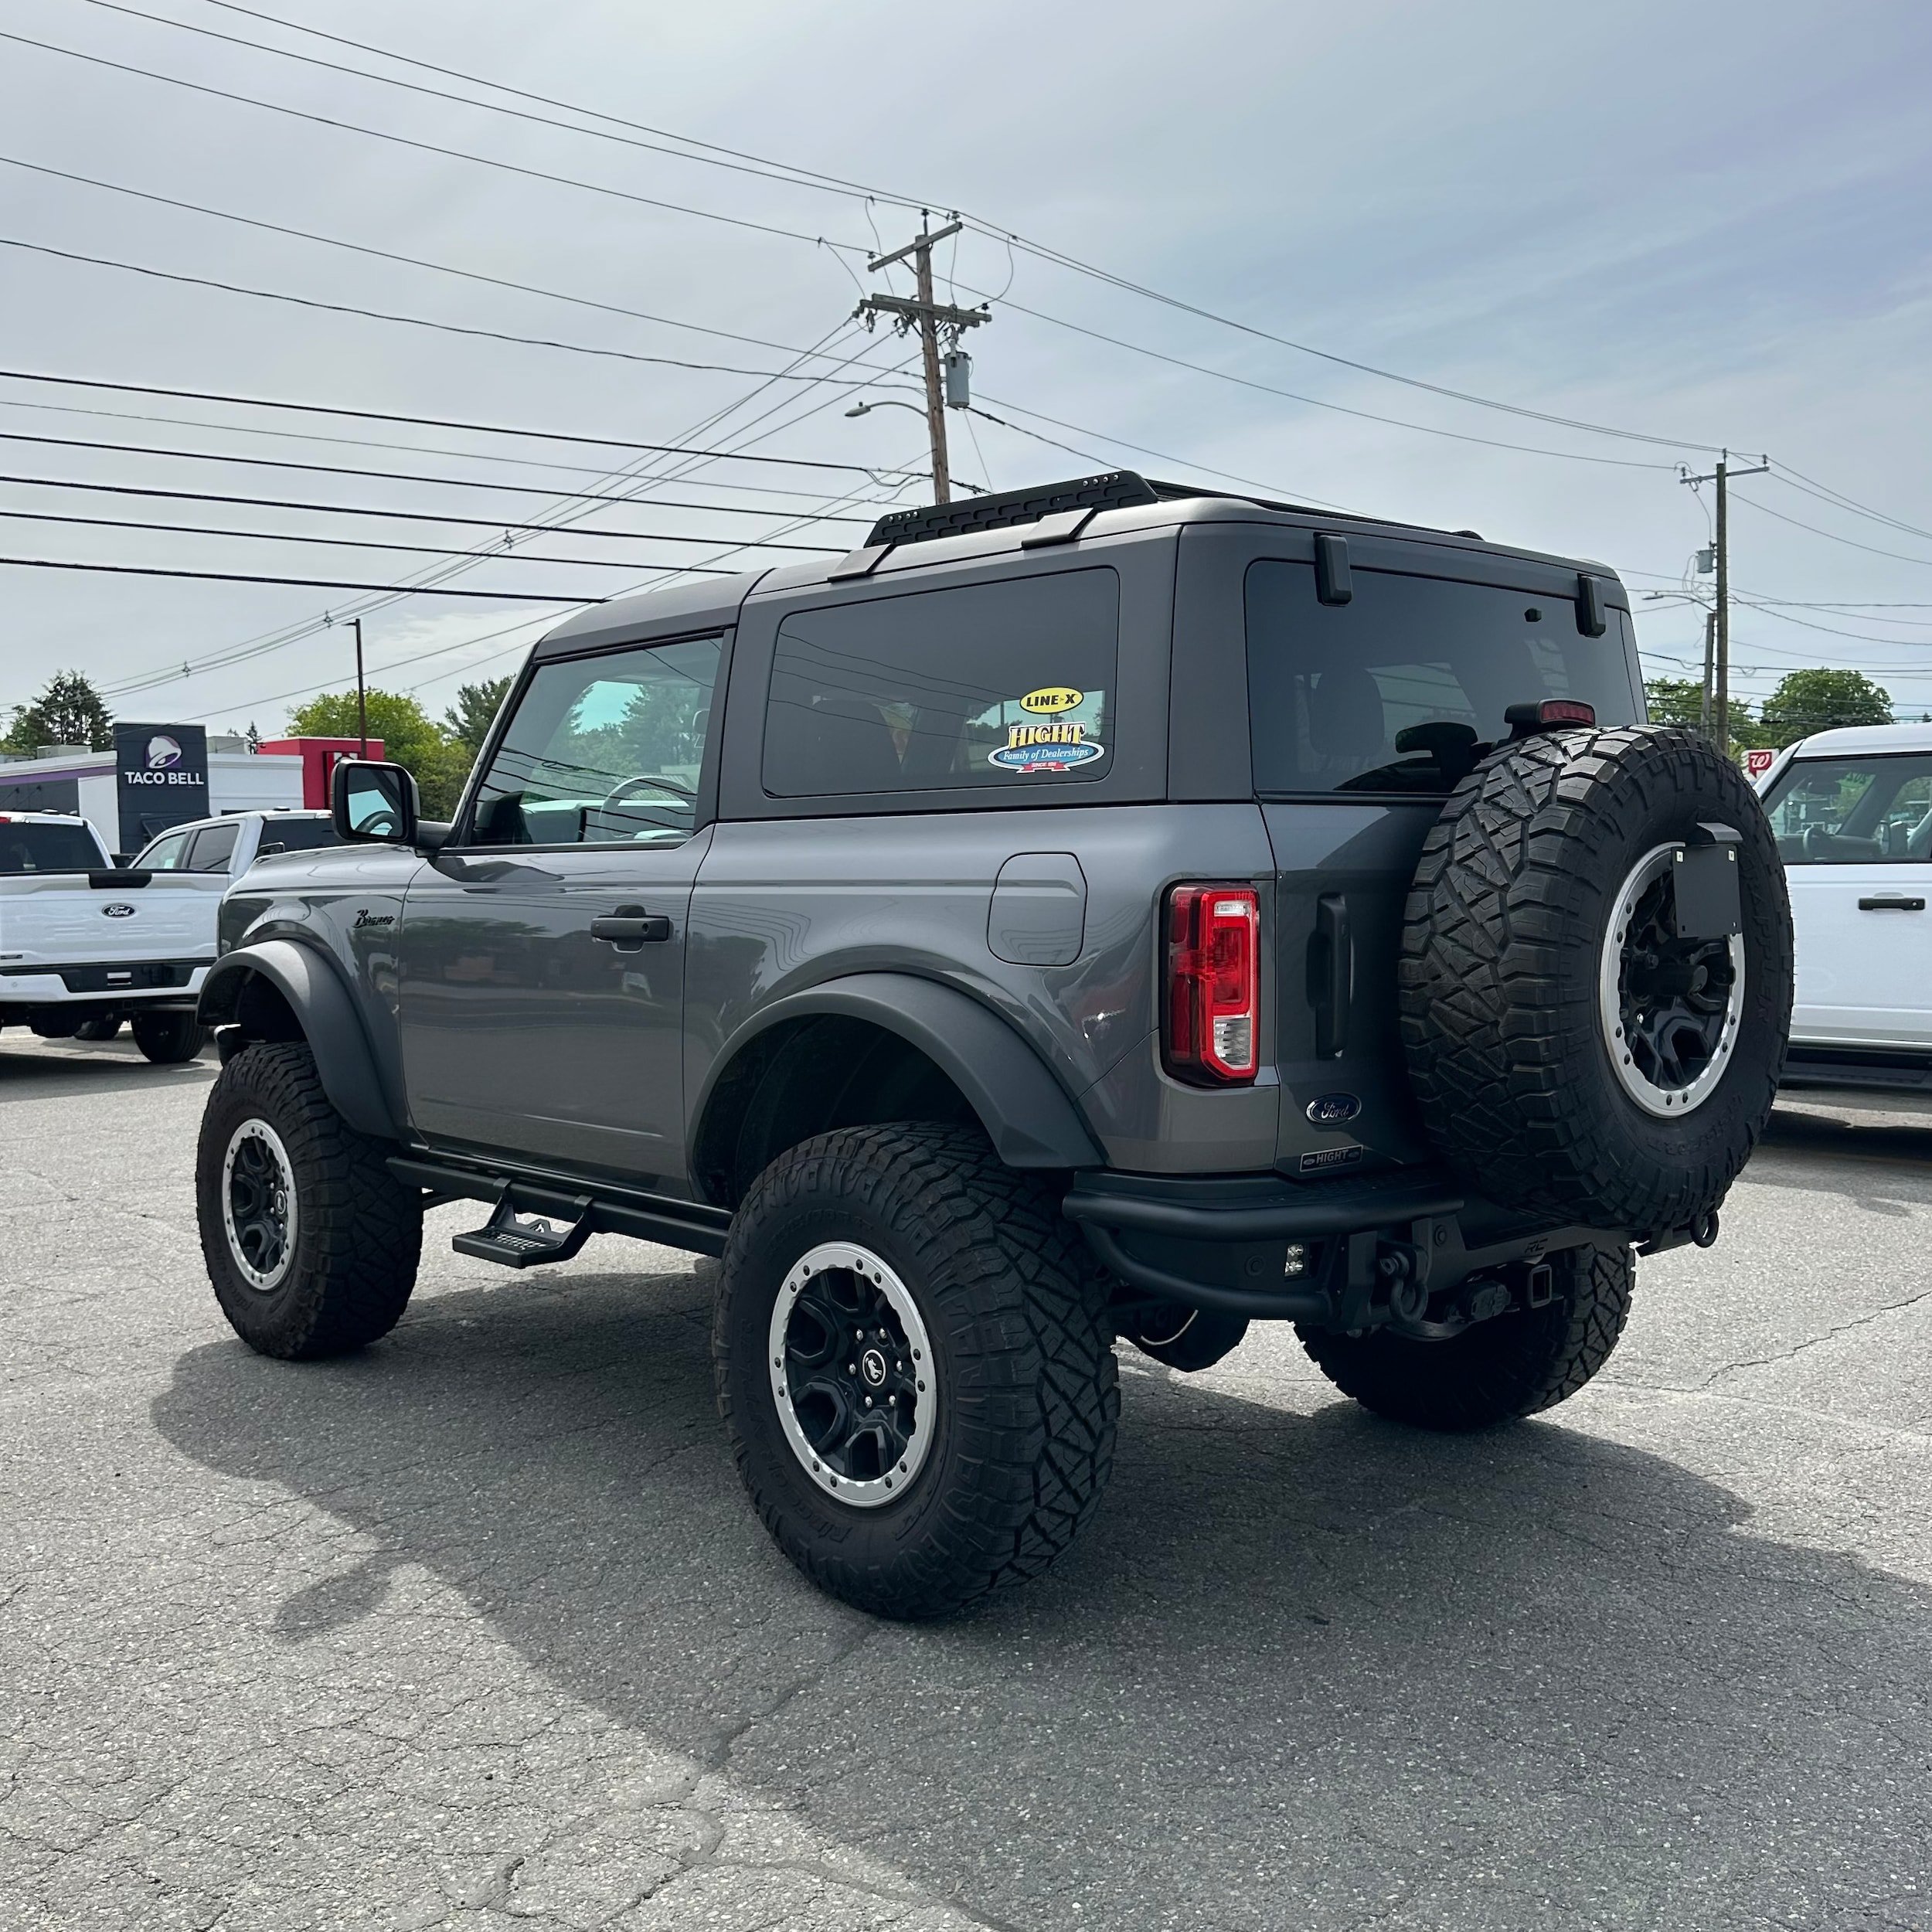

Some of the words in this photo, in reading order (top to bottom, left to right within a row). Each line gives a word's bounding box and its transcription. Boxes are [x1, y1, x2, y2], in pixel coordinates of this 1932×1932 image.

[1026, 693, 1077, 707] LINE-X
[1009, 723, 1085, 750] HIGHT
[1003, 750, 1029, 761] Family
[1031, 750, 1040, 761] of
[1041, 747, 1089, 759] Dealerships
[124, 771, 165, 784] TACO
[168, 772, 205, 785] BELL
[107, 906, 131, 916] Ford
[352, 909, 396, 928] Bronco
[1321, 1100, 1349, 1119] Ford
[1315, 1149, 1349, 1165] HIGHT
